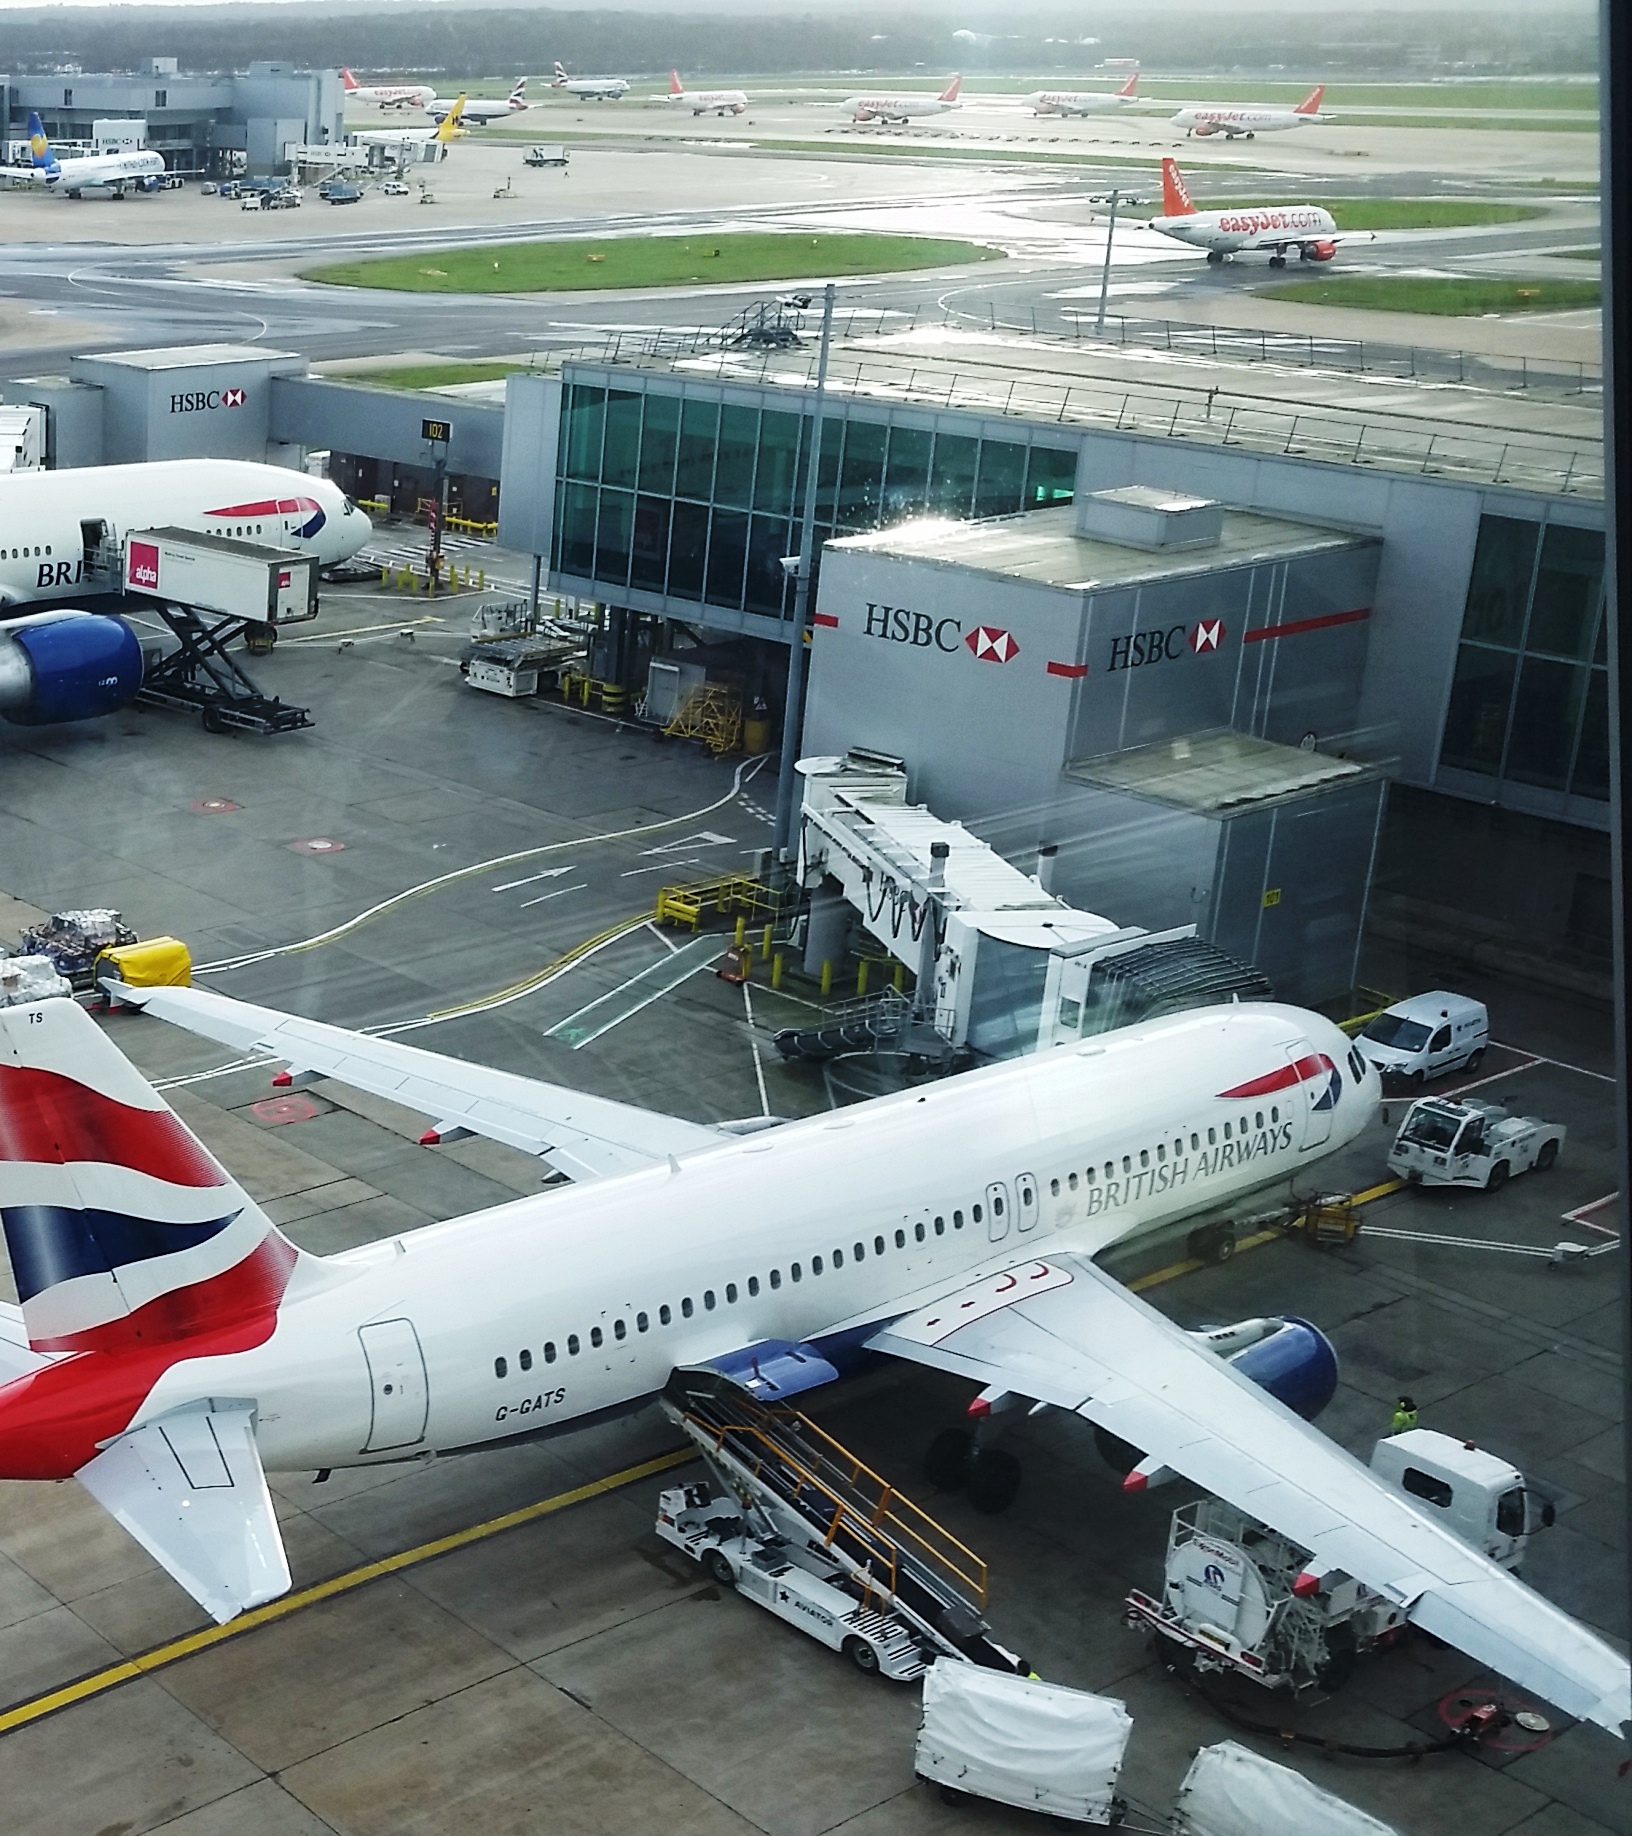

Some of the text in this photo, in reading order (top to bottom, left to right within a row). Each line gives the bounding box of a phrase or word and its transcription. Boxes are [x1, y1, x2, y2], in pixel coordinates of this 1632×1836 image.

[1169, 164, 1190, 208] easyJet
[1220, 211, 1322, 236] easyJet.com
[170, 390, 220, 413] HSBC
[429, 423, 443, 439] 102
[37, 560, 82, 588] BRI
[136, 564, 157, 584] alpha
[863, 602, 962, 653] HSBC
[1107, 624, 1187, 672] HSBC
[29, 1012, 43, 1024] TS
[1087, 1121, 1294, 1217] BRITISH AIRWAYS
[495, 1387, 566, 1421] G-GATS
